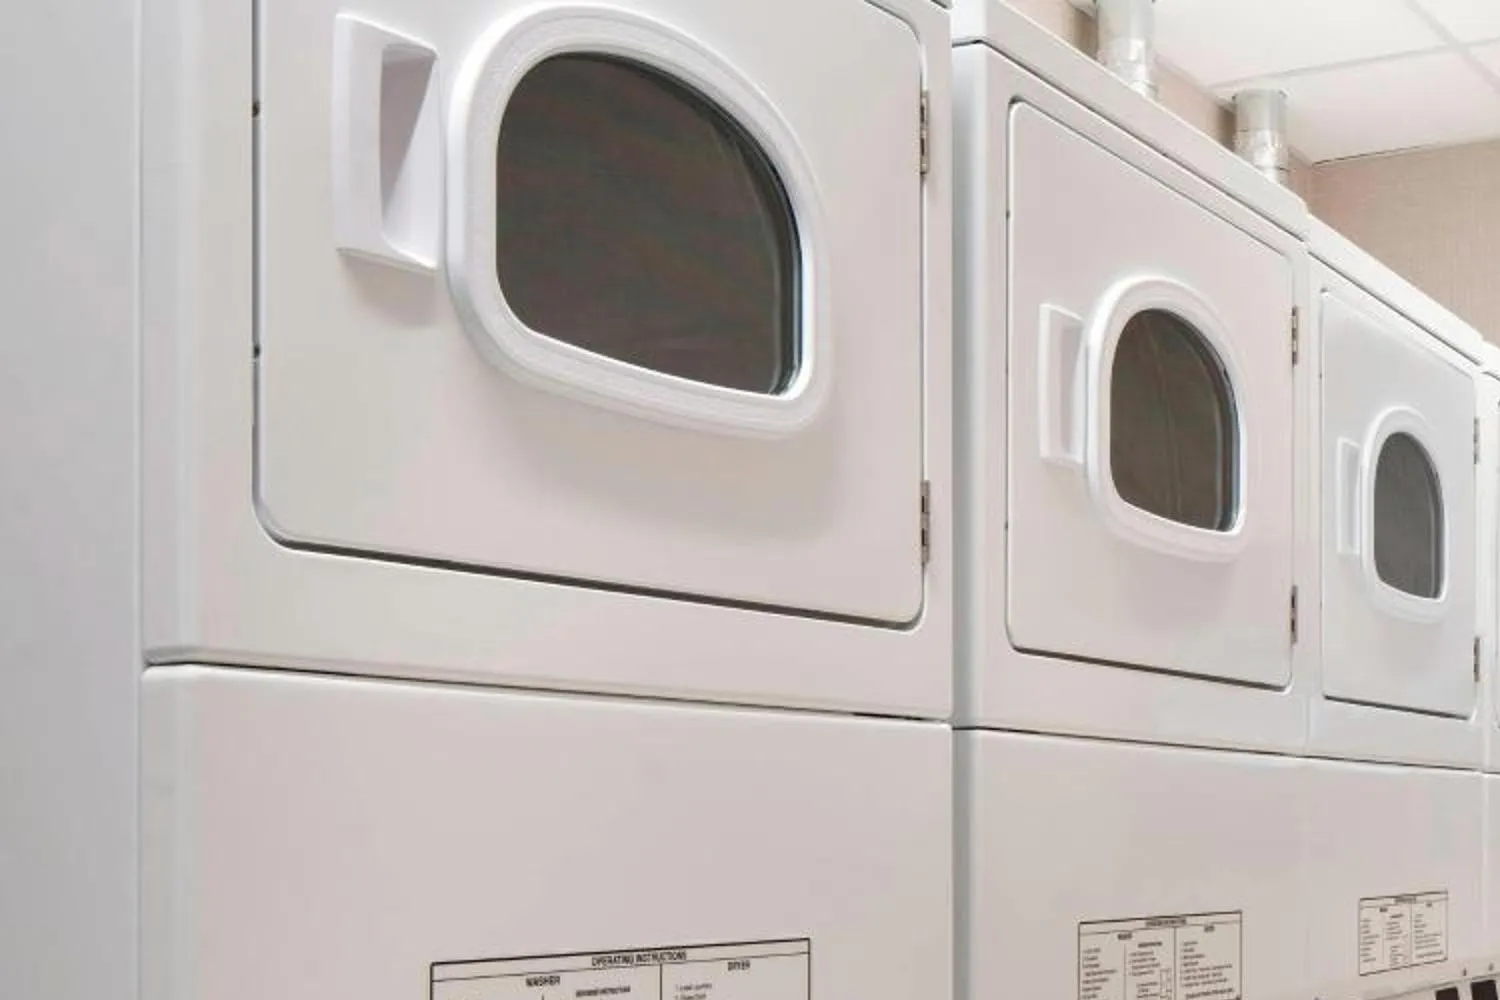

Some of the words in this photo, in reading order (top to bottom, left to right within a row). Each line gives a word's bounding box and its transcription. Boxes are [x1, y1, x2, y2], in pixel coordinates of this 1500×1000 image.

[592, 955, 634, 967] OPERATING
[636, 950, 686, 963] INSTRUCTIONS
[526, 975, 560, 987] WASHER
